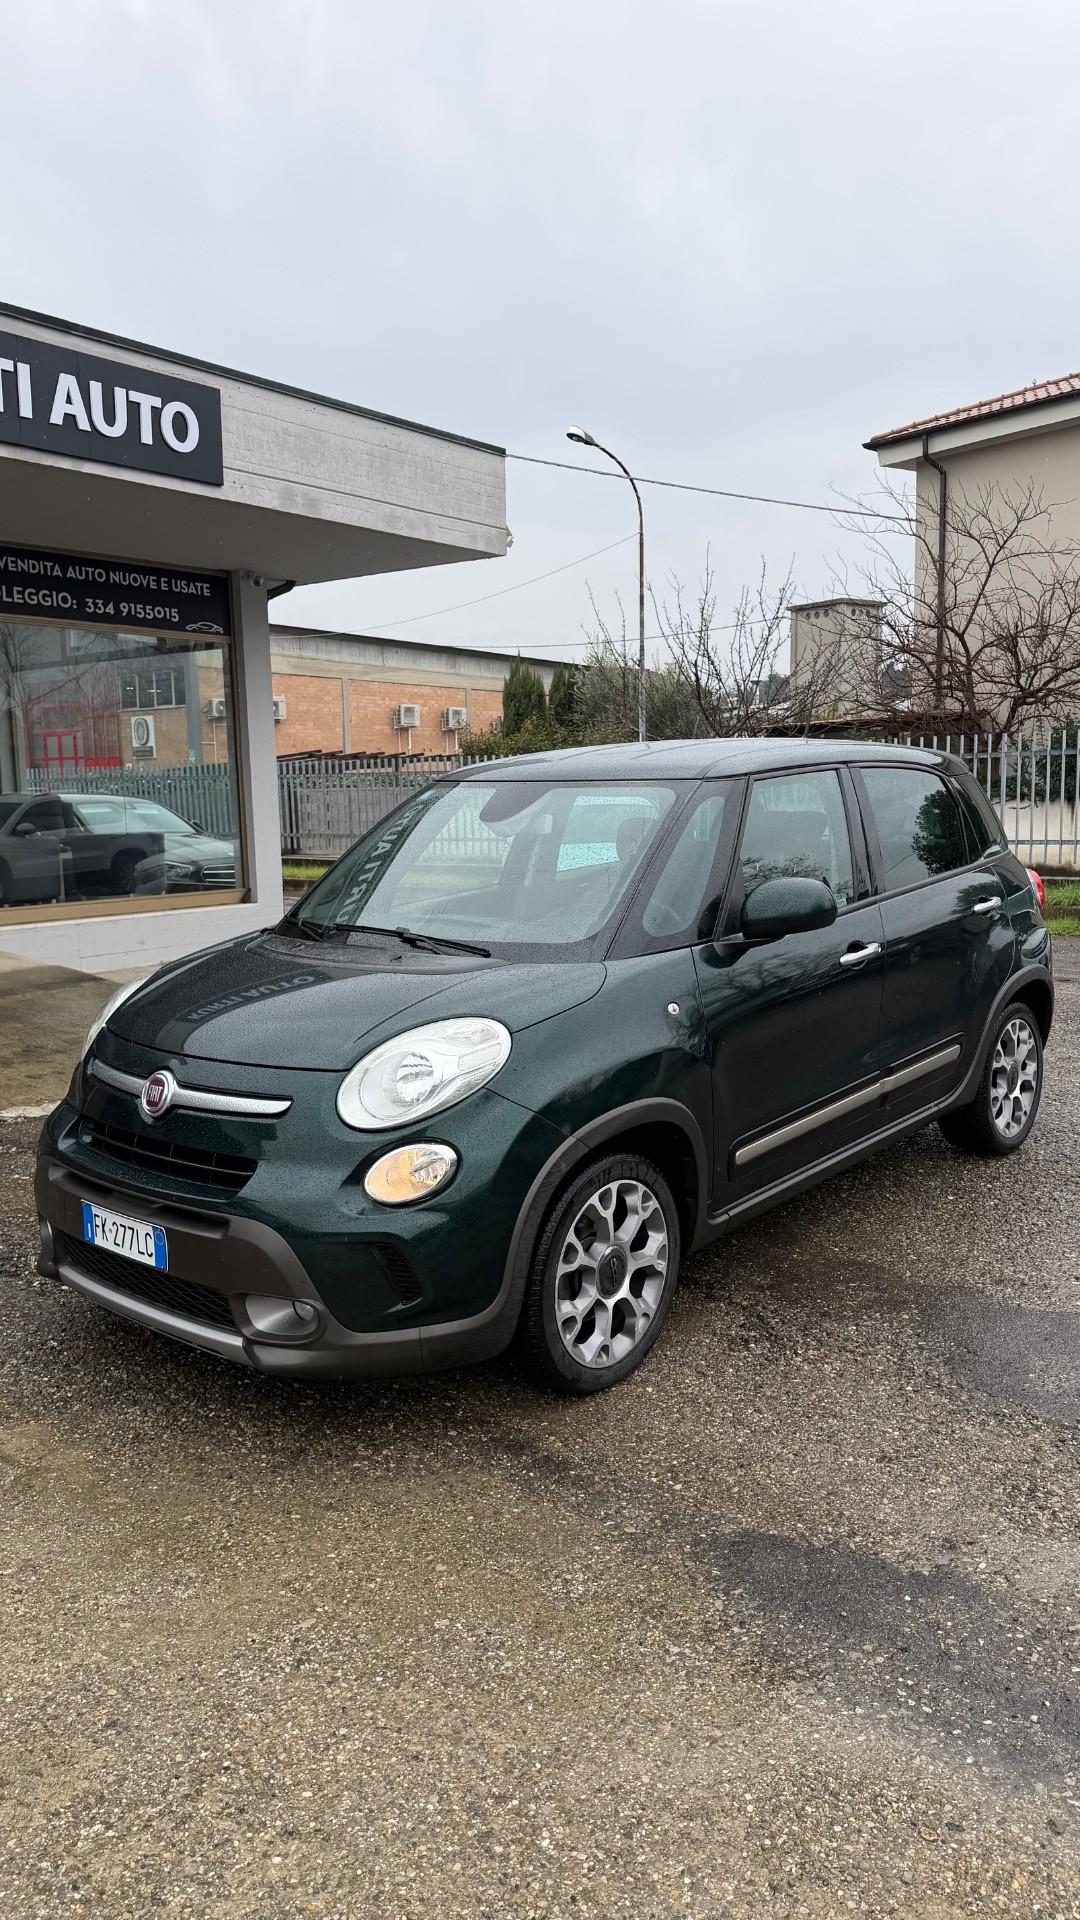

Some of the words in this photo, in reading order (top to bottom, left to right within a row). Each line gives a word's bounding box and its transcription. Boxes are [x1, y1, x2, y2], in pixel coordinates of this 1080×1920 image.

[49, 373, 200, 453] AUTO
[0, 556, 63, 578] VENDITA
[66, 565, 106, 583] AUTO
[109, 570, 158, 590] NUOVE
[161, 577, 169, 591] E
[172, 579, 212, 597] USATE
[0, 585, 77, 609] LEGGIO:
[85, 598, 115, 616] 334
[120, 602, 180, 623] 9155015
[146, 1084, 164, 1103] FIAT
